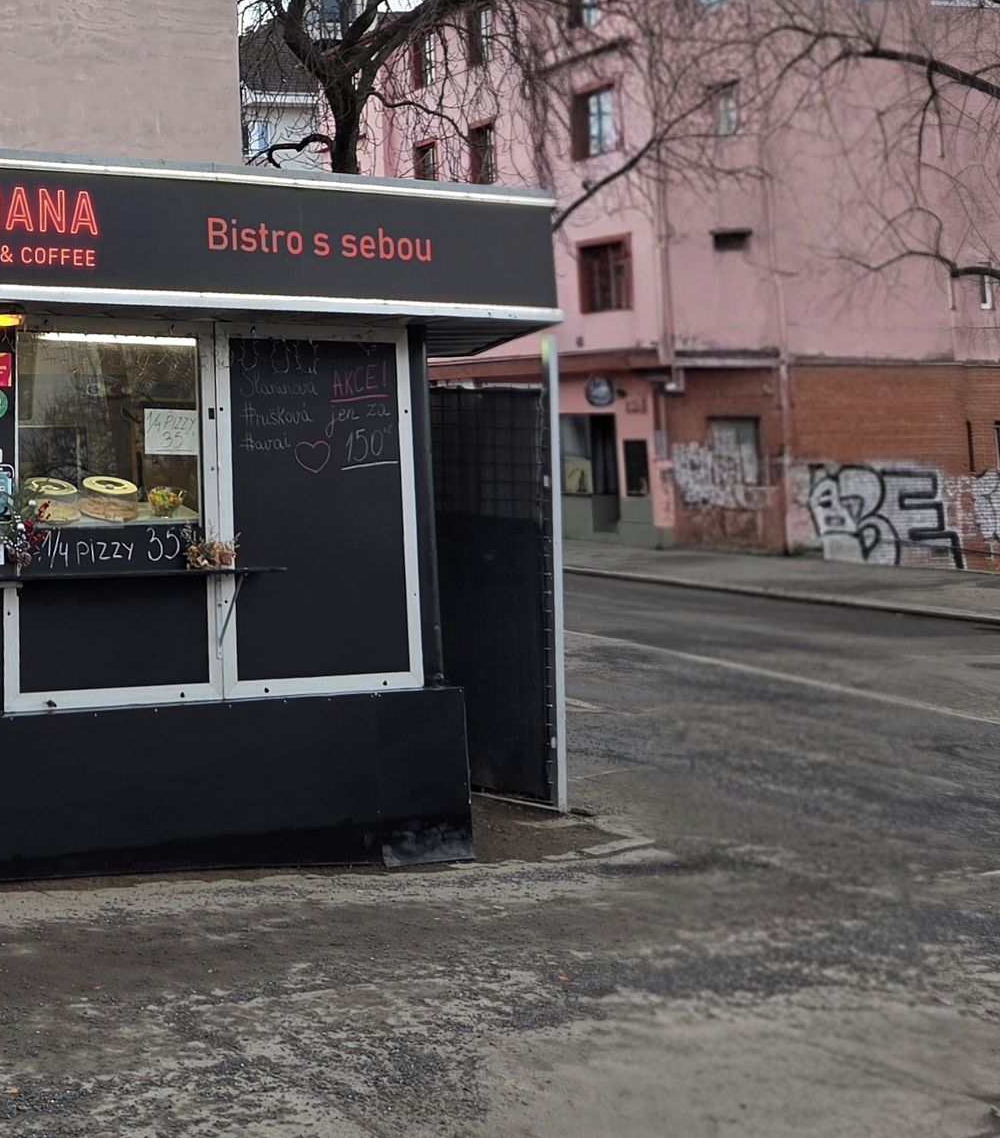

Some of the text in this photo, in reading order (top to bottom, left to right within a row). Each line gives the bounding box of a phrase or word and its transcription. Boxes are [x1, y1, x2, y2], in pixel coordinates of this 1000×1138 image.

[0, 245, 14, 264] &
[20, 247, 97, 268] COFFEE
[207, 217, 432, 262] Bistro s sebou
[332, 361, 387, 396] AKCE!
[325, 403, 391, 438] jen za
